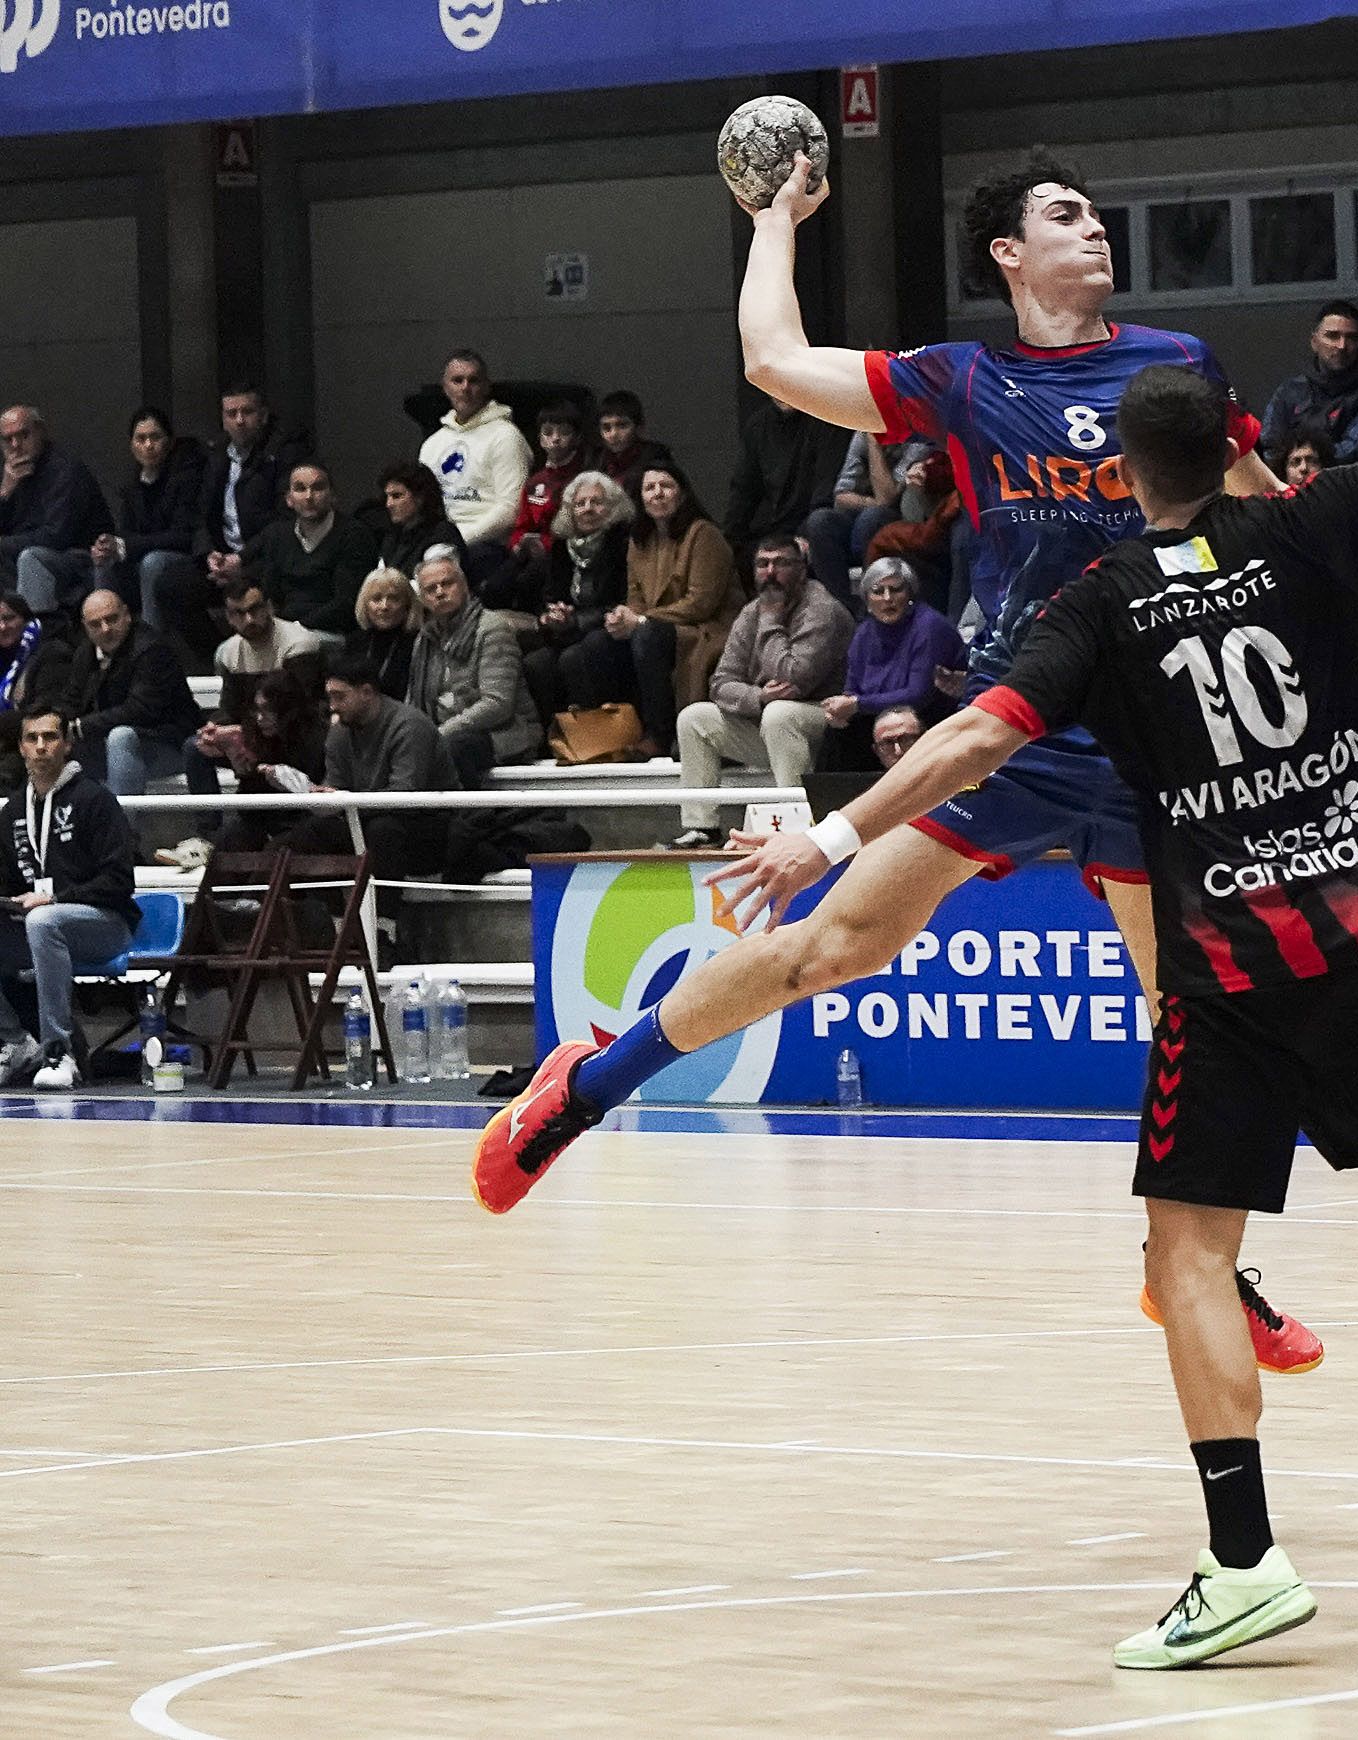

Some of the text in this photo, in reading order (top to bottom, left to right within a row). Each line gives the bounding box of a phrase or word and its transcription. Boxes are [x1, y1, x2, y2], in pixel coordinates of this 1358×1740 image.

[75, 0, 231, 39] Pontevedra
[848, 78, 873, 115] A
[223, 130, 249, 166] A
[1063, 405, 1107, 450] 8
[1133, 570, 1276, 632] LANZAROTE
[1159, 625, 1308, 767] 10
[1243, 821, 1322, 859] Islas
[876, 929, 1125, 978] PORTE
